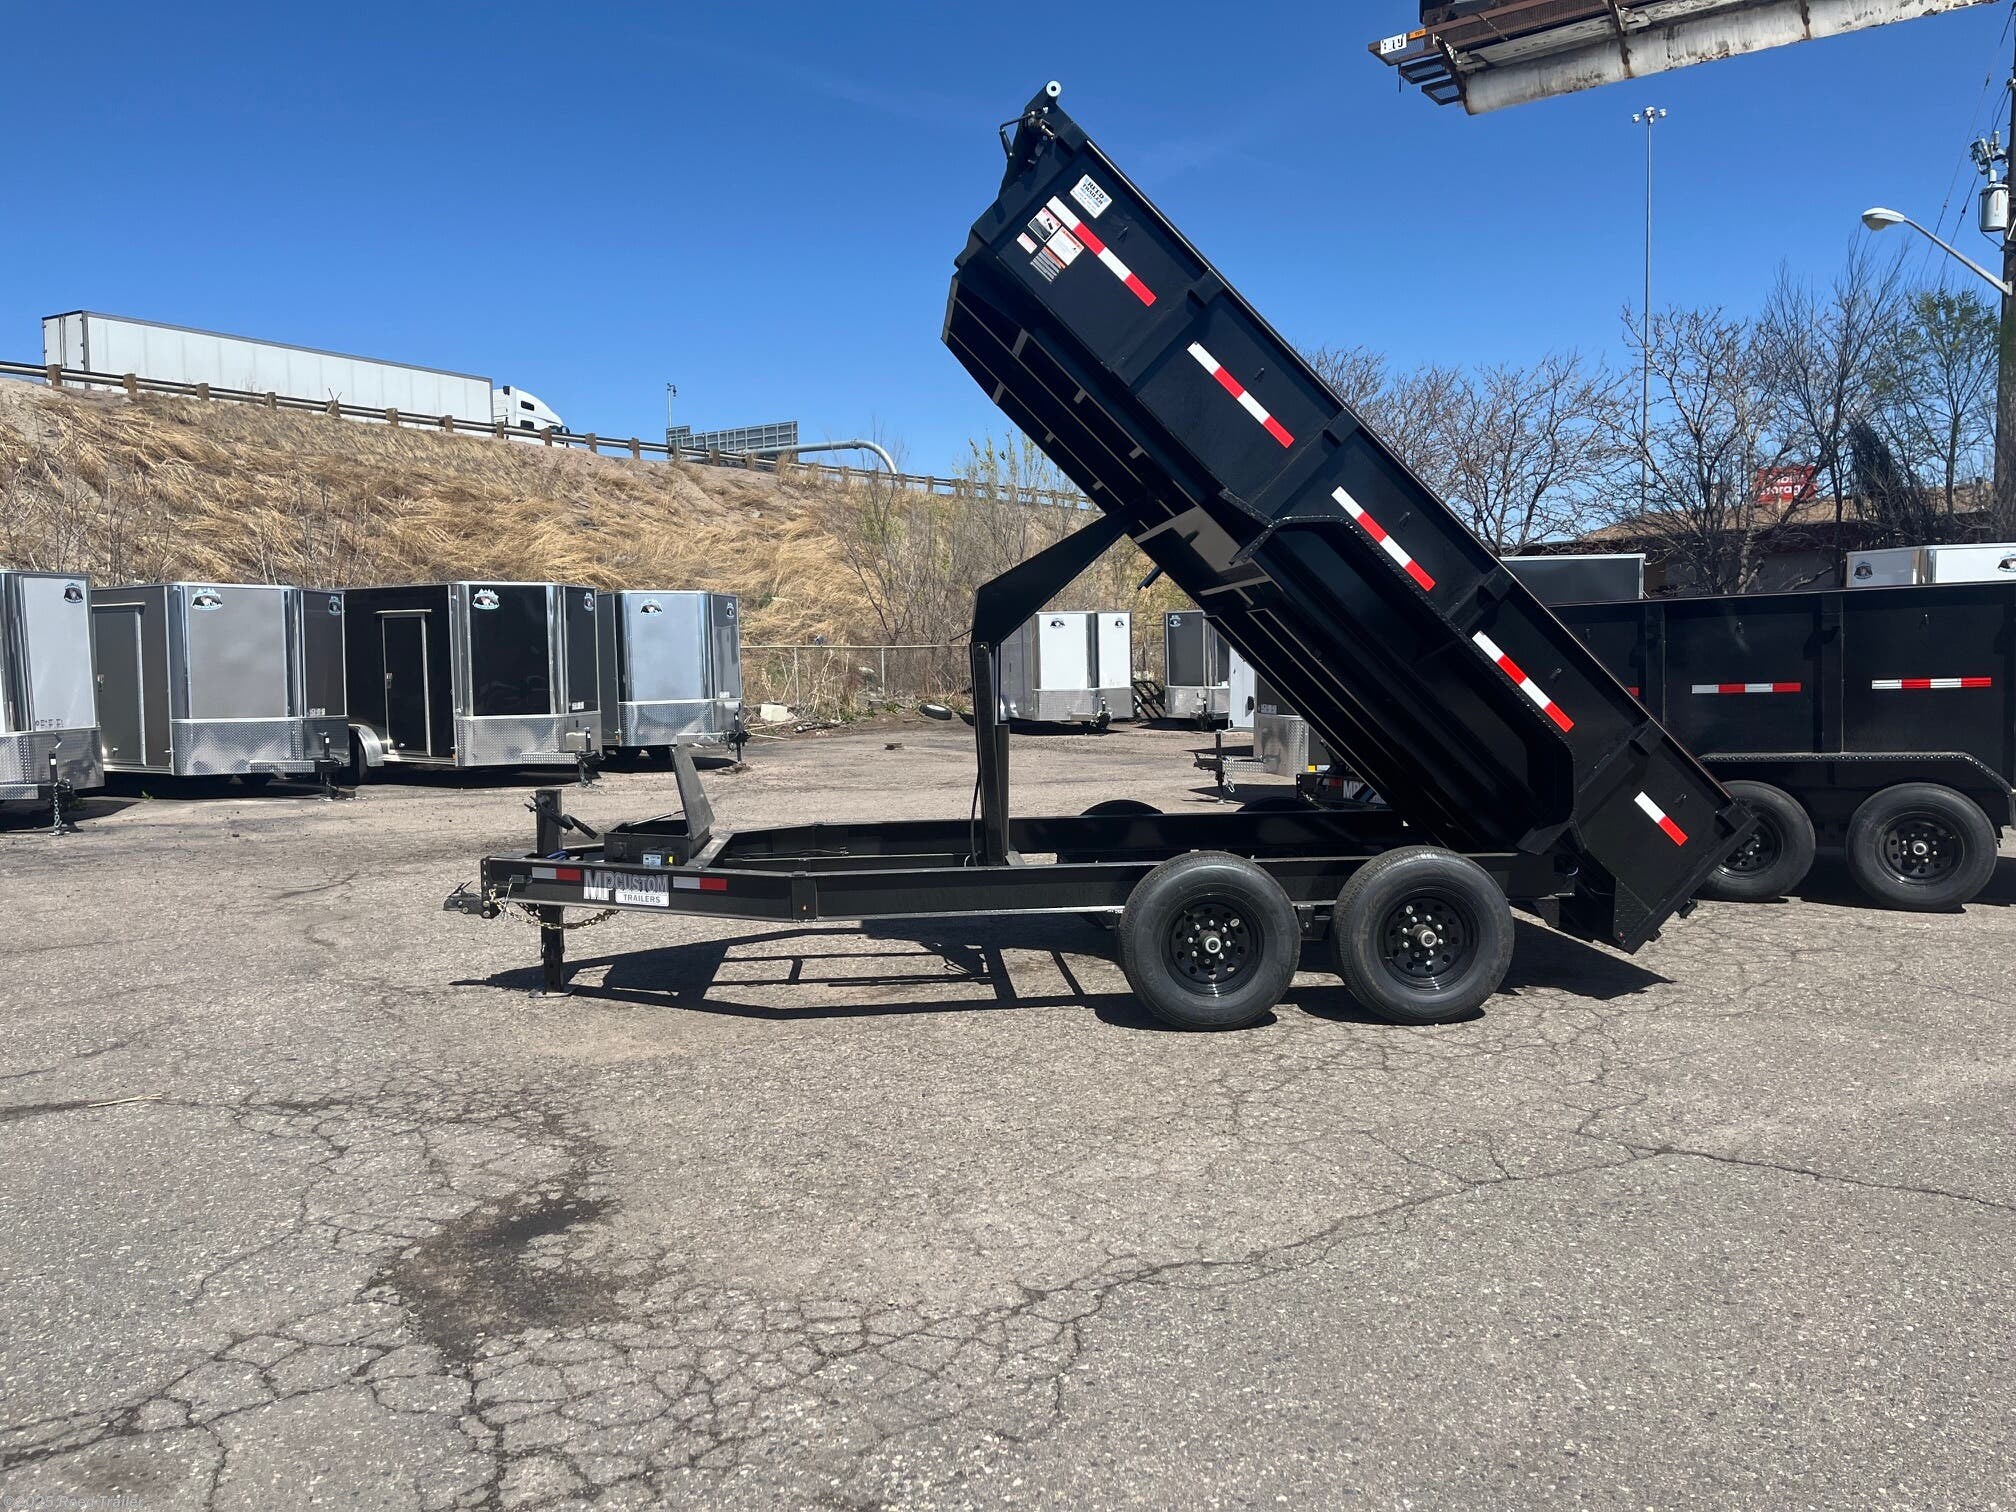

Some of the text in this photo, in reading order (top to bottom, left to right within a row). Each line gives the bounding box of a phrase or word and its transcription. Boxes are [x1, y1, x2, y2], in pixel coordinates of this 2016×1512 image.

[1082, 183, 1103, 205] TRAILER
[1087, 181, 1105, 199] REED
[584, 869, 669, 900] MP CUSTOM
[623, 893, 661, 904] TRAILERS
